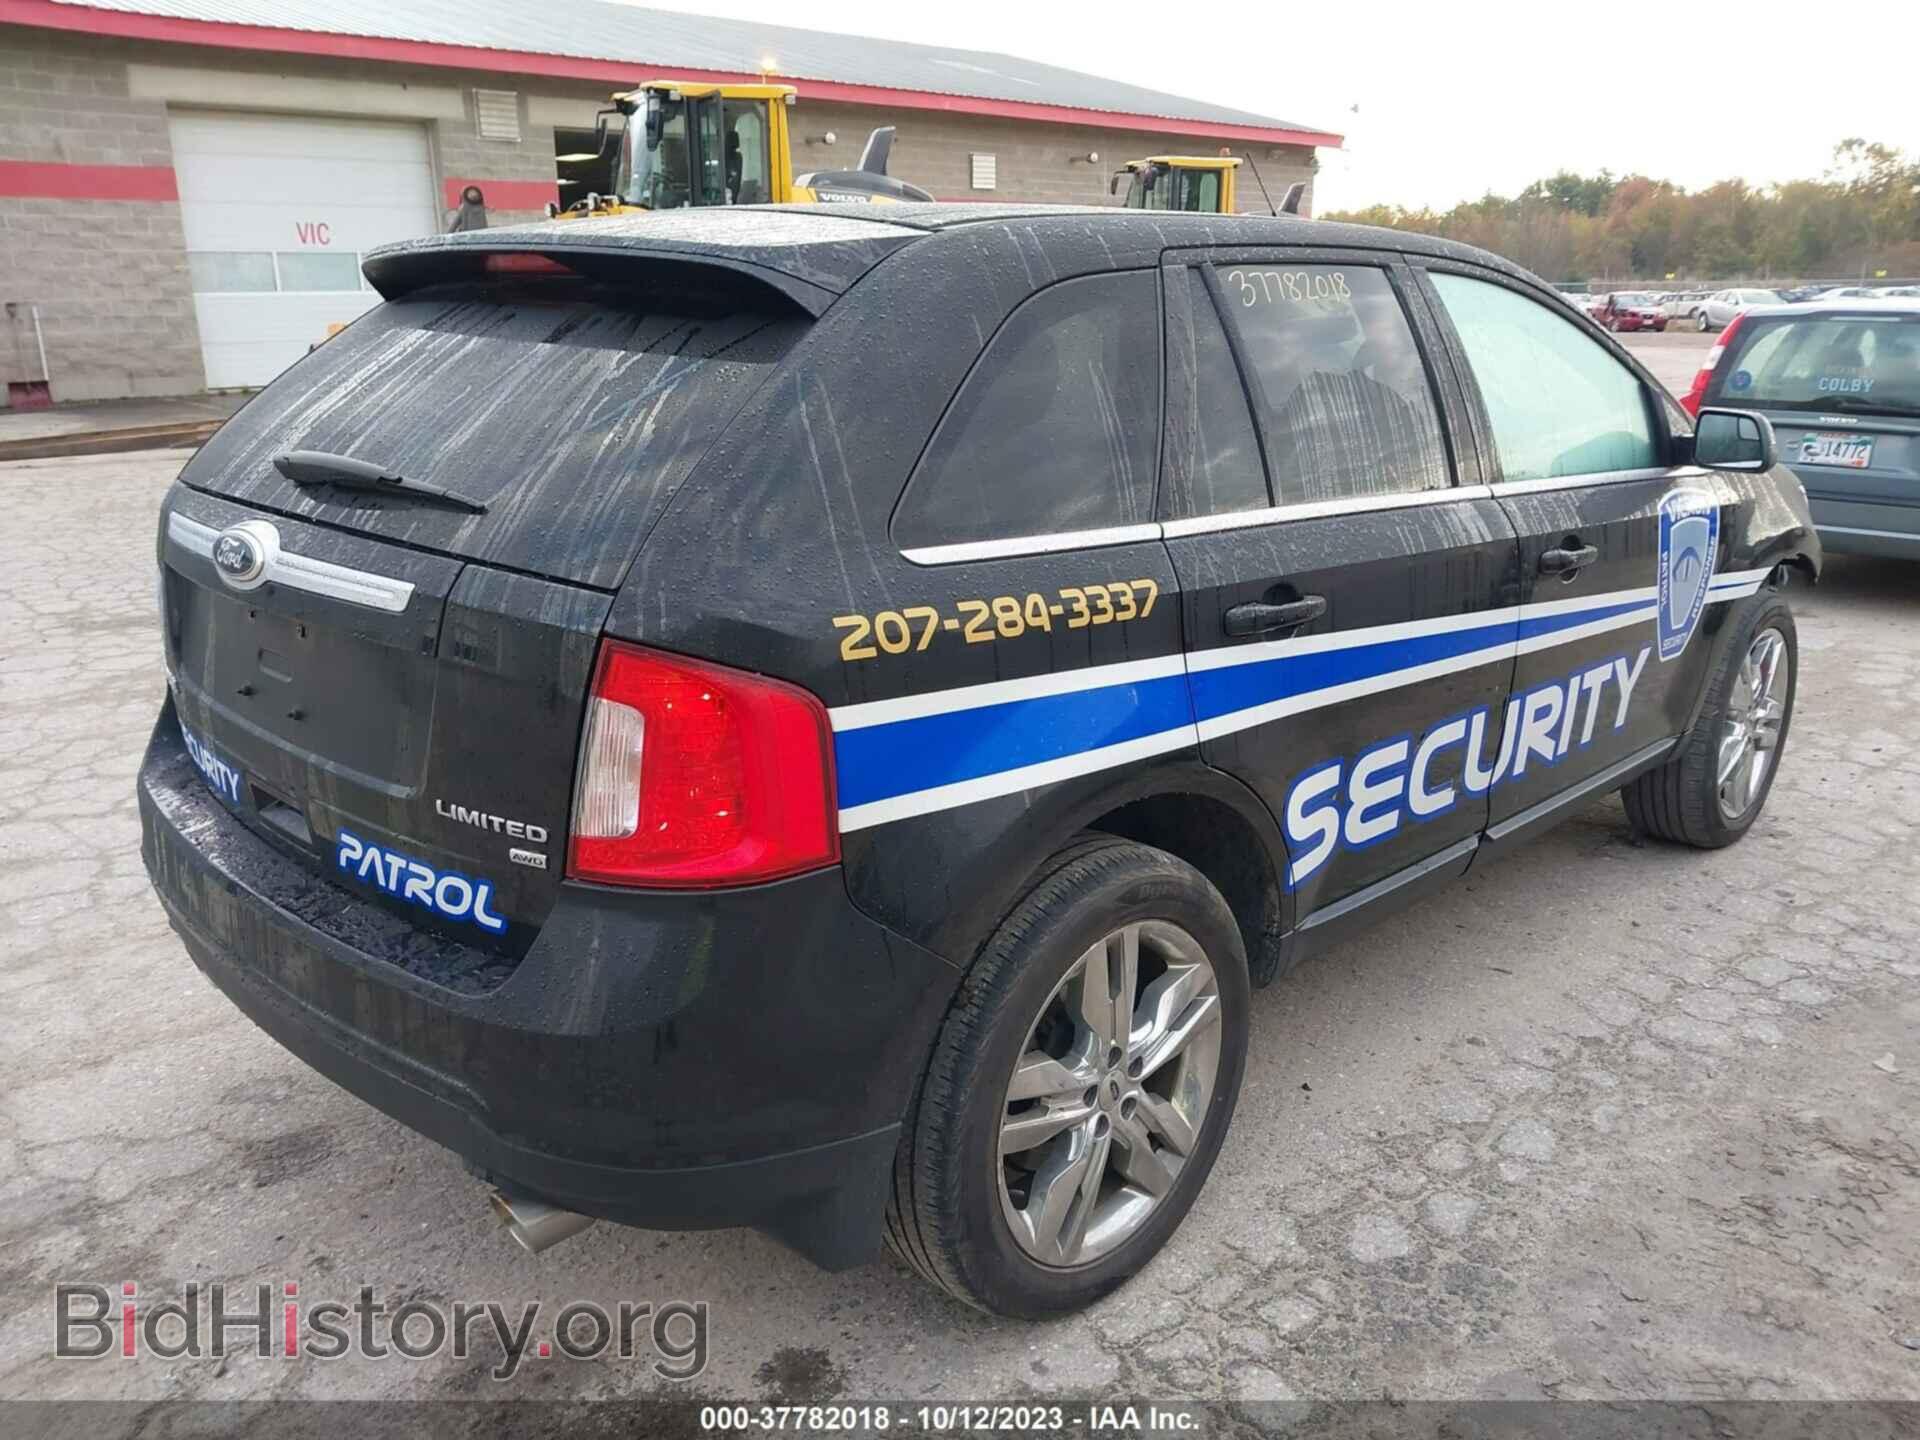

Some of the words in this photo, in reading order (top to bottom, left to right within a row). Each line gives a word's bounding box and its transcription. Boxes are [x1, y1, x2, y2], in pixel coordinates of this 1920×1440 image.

[295, 221, 331, 245] VIC
[1228, 270, 1352, 307] 37782018
[1819, 376, 1874, 393] COLBY
[216, 536, 246, 569] Ford
[832, 579, 1158, 661] 207-284-3337
[1286, 647, 1652, 886] SECURITY
[435, 799, 548, 843] LIMITED
[511, 851, 545, 867] AWD
[338, 832, 503, 929] PATROL
